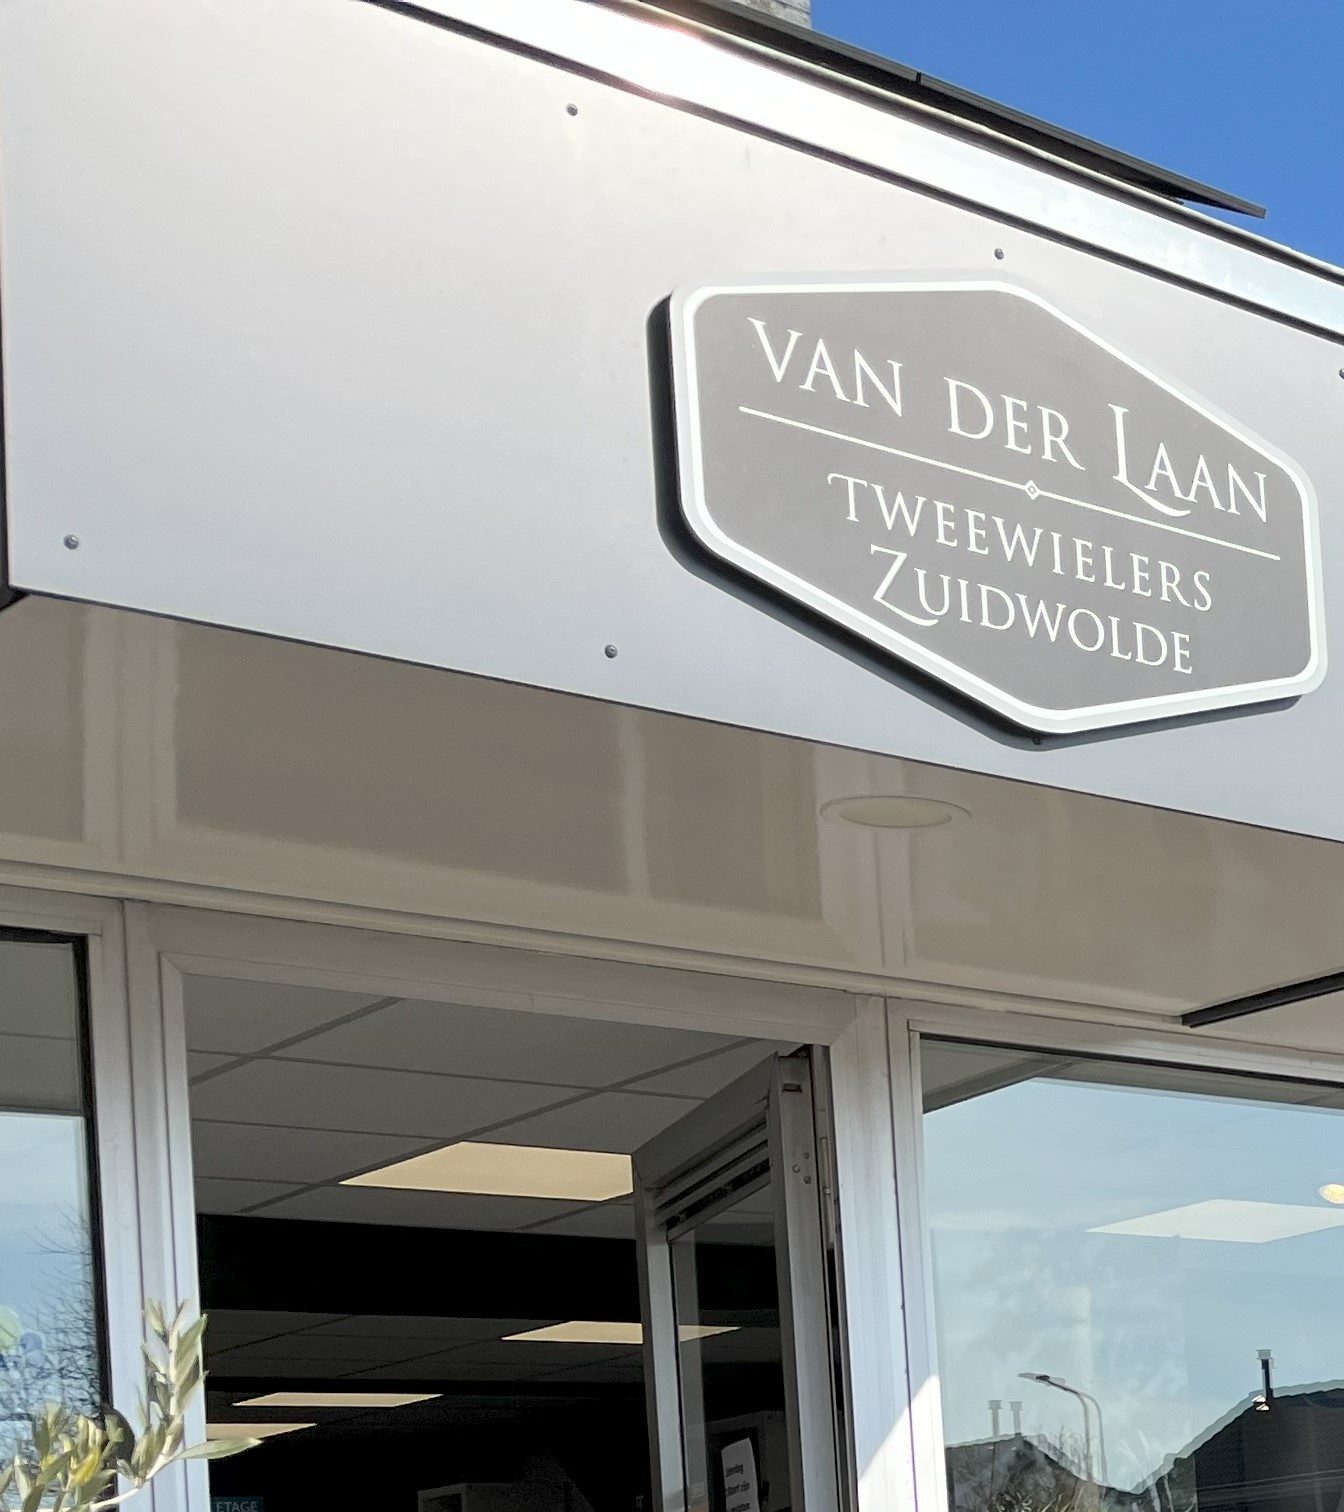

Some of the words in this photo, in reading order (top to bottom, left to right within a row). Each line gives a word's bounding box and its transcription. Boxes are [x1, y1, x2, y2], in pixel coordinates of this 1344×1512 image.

[747, 317, 903, 418] VAN
[944, 377, 1086, 471] DER
[1108, 403, 1269, 523] LAAN
[827, 472, 1213, 611] TWEEWIELERS
[870, 545, 1193, 674] ZUIDWOLDE
[216, 1500, 258, 1512] ETAGE
